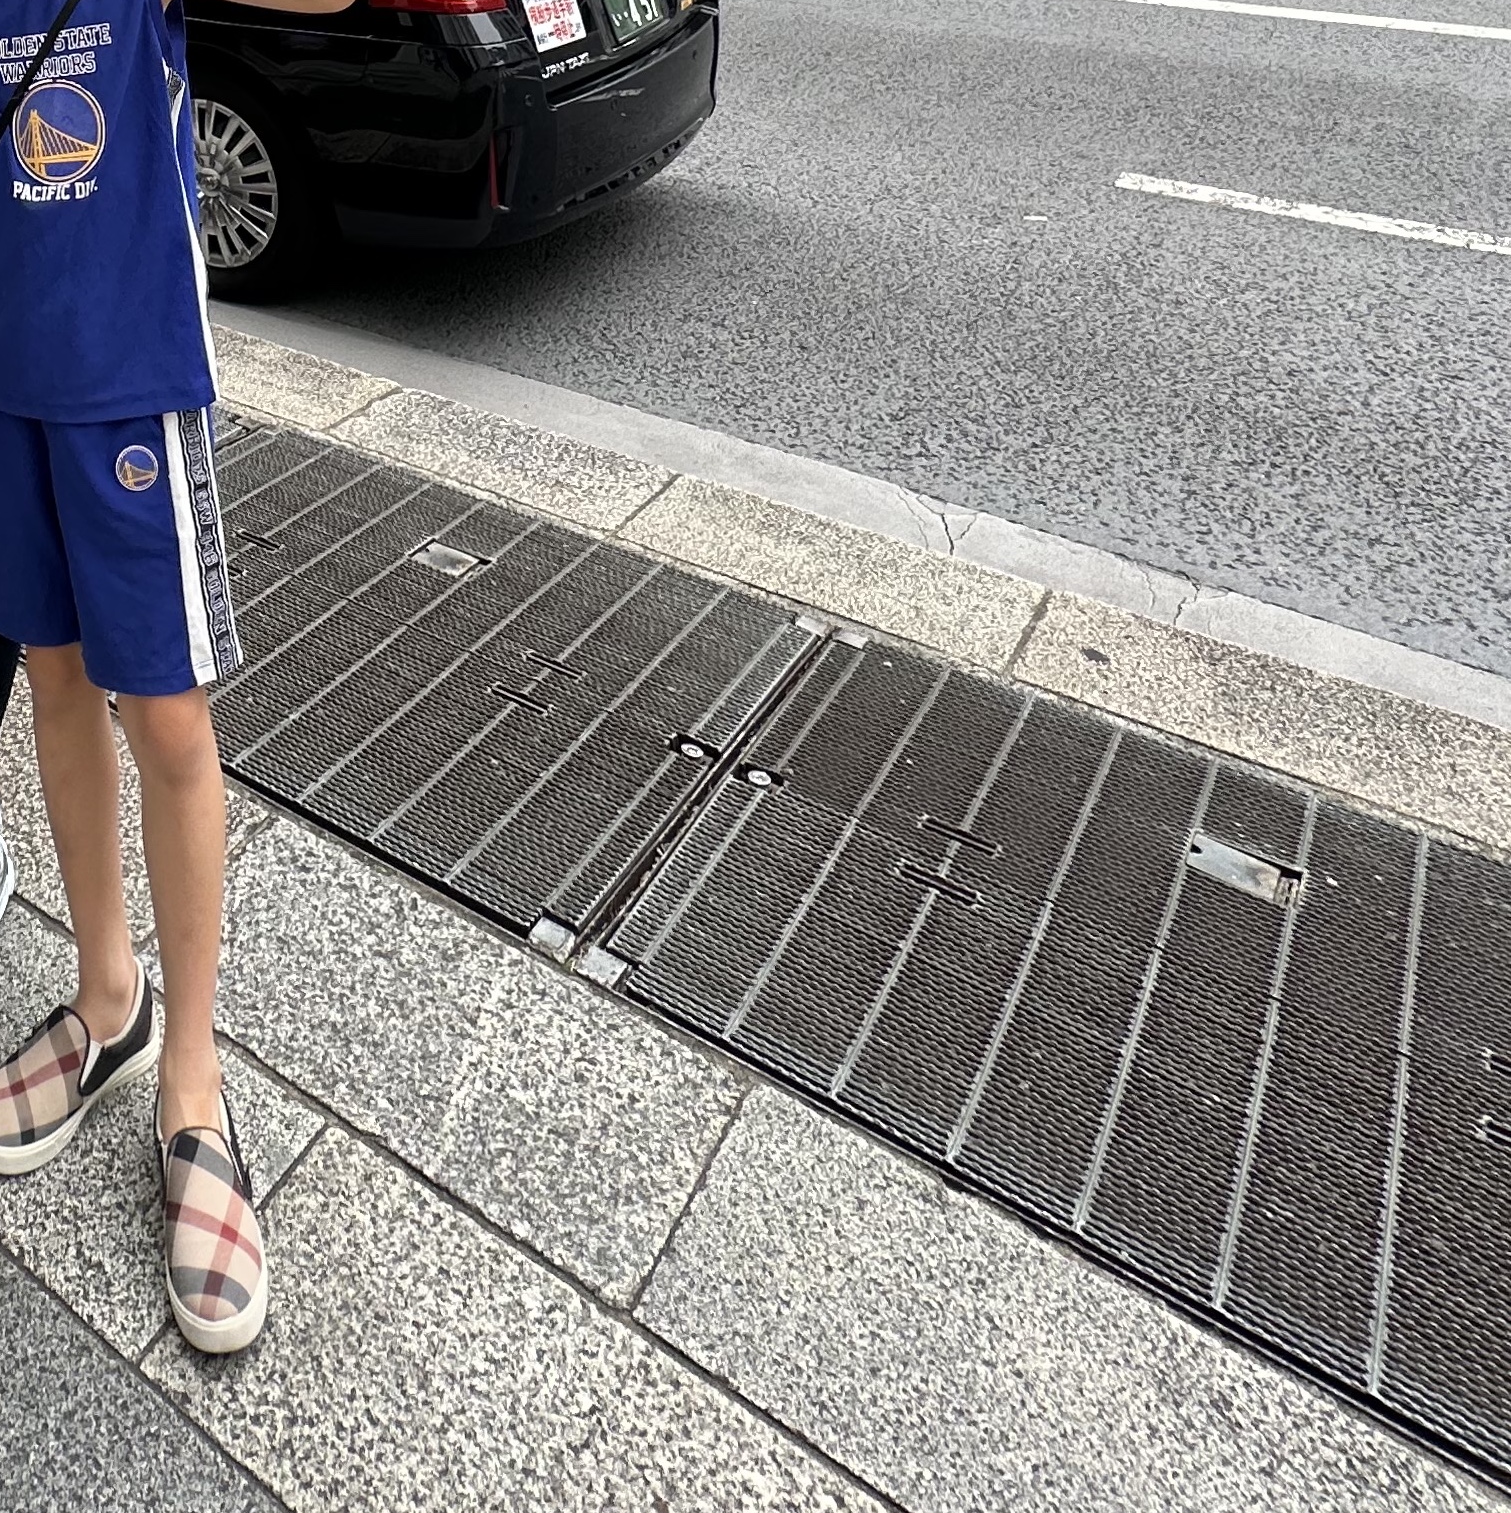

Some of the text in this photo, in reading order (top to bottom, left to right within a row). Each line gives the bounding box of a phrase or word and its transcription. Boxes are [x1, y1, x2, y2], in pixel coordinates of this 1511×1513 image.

[54, 23, 112, 52] STATE
[0, 51, 98, 84] WARIORS
[13, 181, 71, 202] PACIFIC
